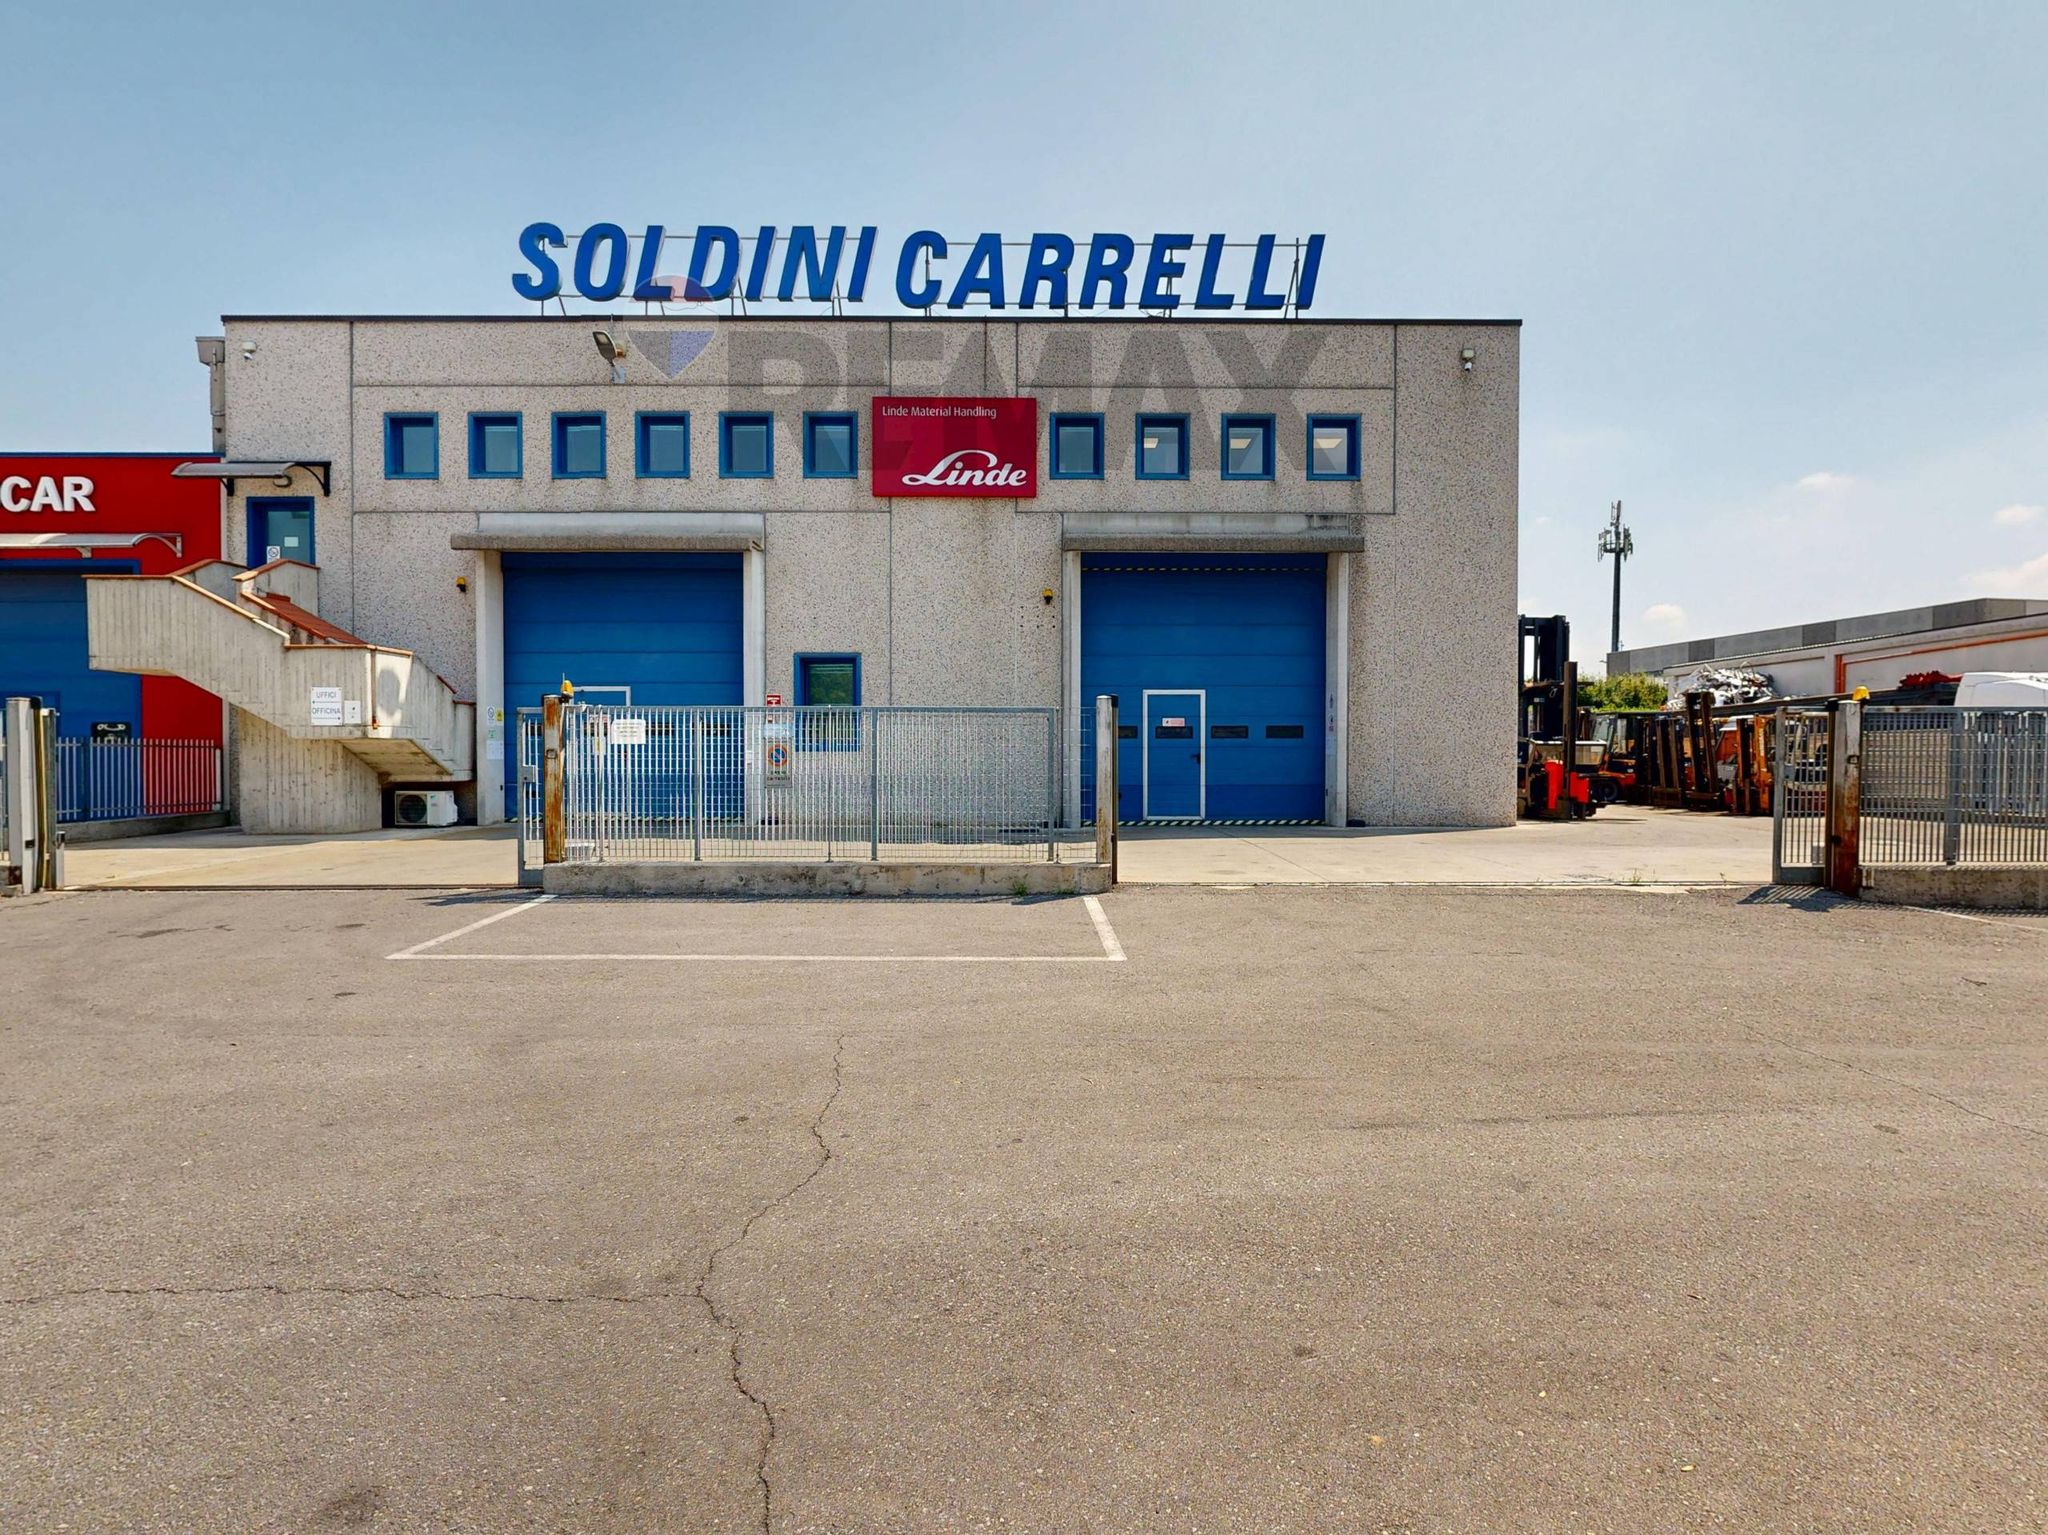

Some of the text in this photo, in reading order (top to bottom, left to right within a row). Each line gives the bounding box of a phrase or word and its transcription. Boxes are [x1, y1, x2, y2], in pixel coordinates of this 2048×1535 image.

[512, 222, 1326, 310] SOLDINI CARRELLI
[882, 405, 997, 419] Linde Material Handling
[902, 449, 1027, 487] Linde
[0, 475, 96, 512] CAR
